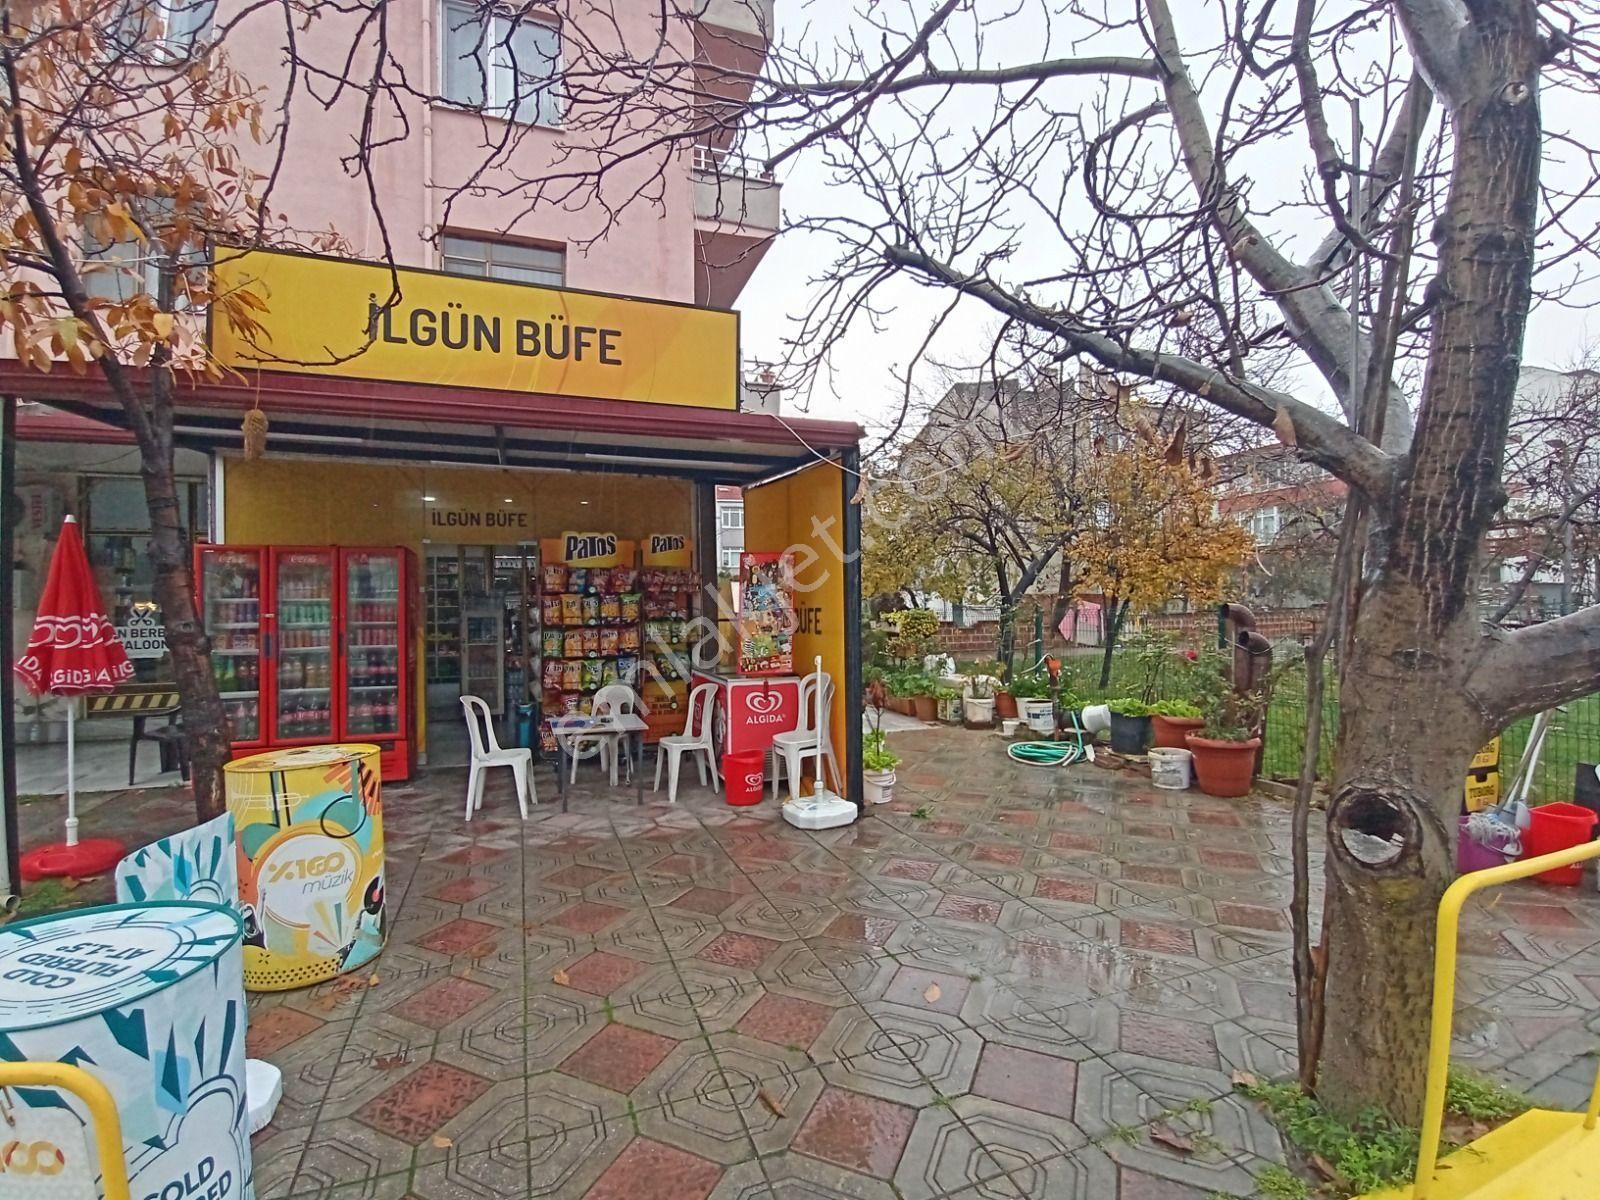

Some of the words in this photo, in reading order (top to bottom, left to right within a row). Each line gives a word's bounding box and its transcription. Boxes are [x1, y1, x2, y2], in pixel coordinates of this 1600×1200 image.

[369, 292, 501, 354] İLGÜN
[516, 313, 622, 366] BÜFE
[431, 508, 480, 526] İLGÜN
[485, 509, 528, 527] BÜFE
[302, 867, 354, 895] müzik
[18, 952, 133, 978] FILTERED
[3, 968, 76, 989] COLD
